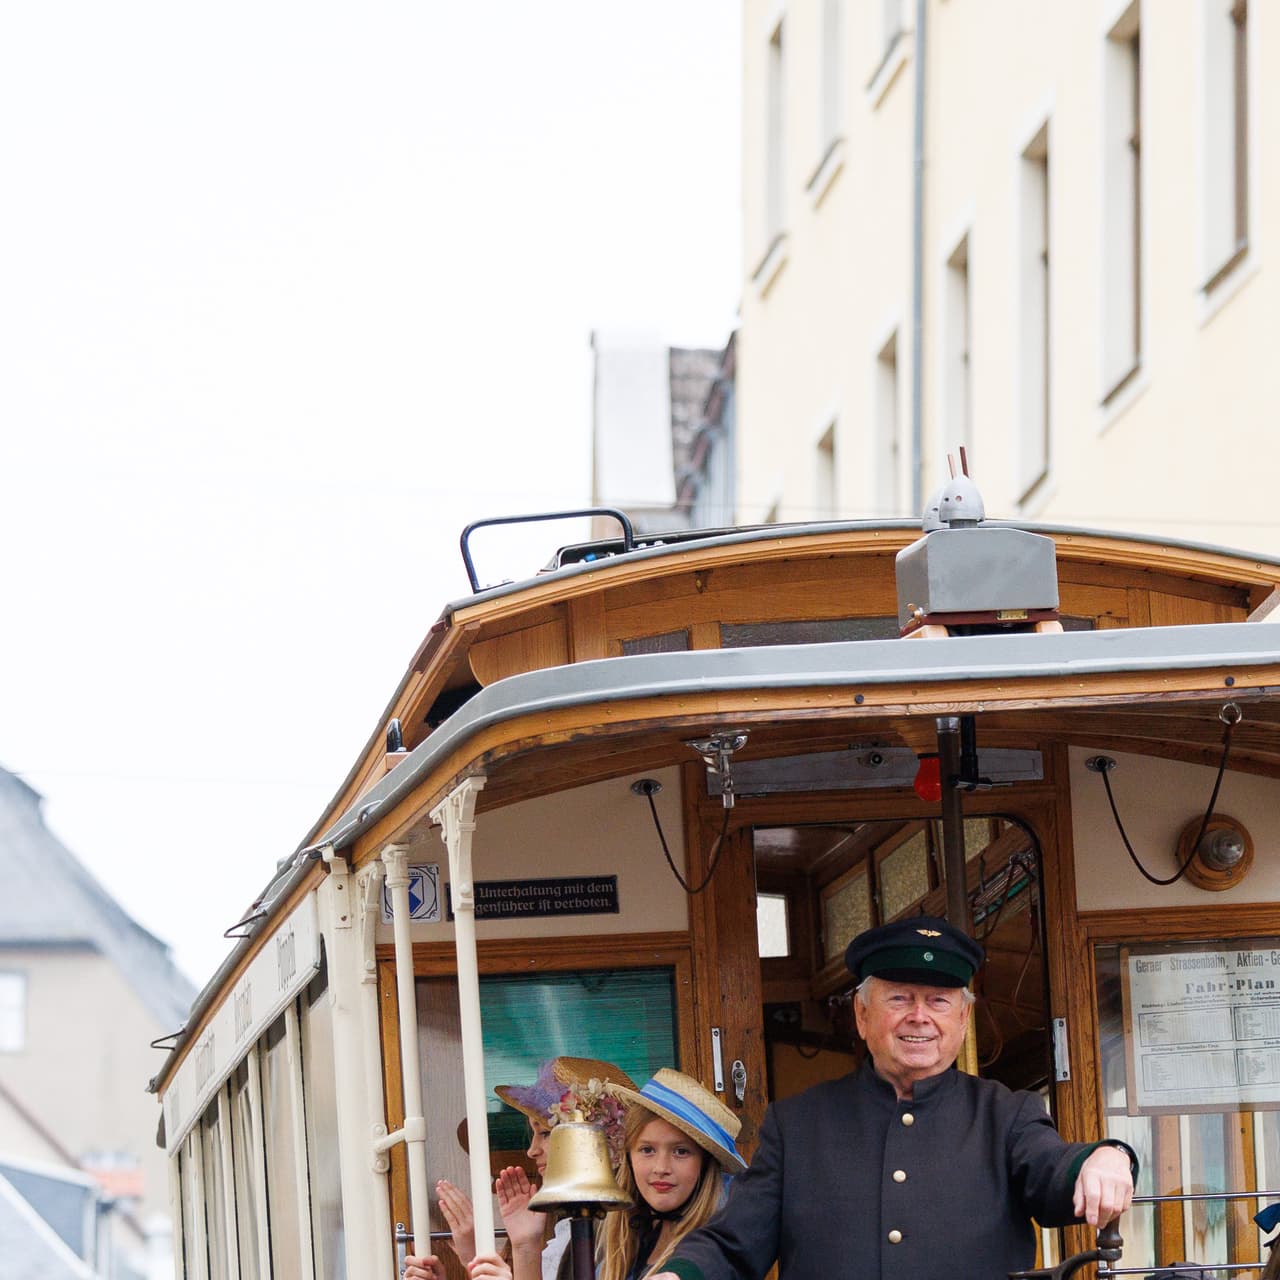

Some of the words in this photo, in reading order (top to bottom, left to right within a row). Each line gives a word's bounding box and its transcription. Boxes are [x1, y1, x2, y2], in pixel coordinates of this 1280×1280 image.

[479, 885, 561, 898] Unterhaltung
[564, 883, 584, 894] mit
[587, 882, 614, 893] dem
